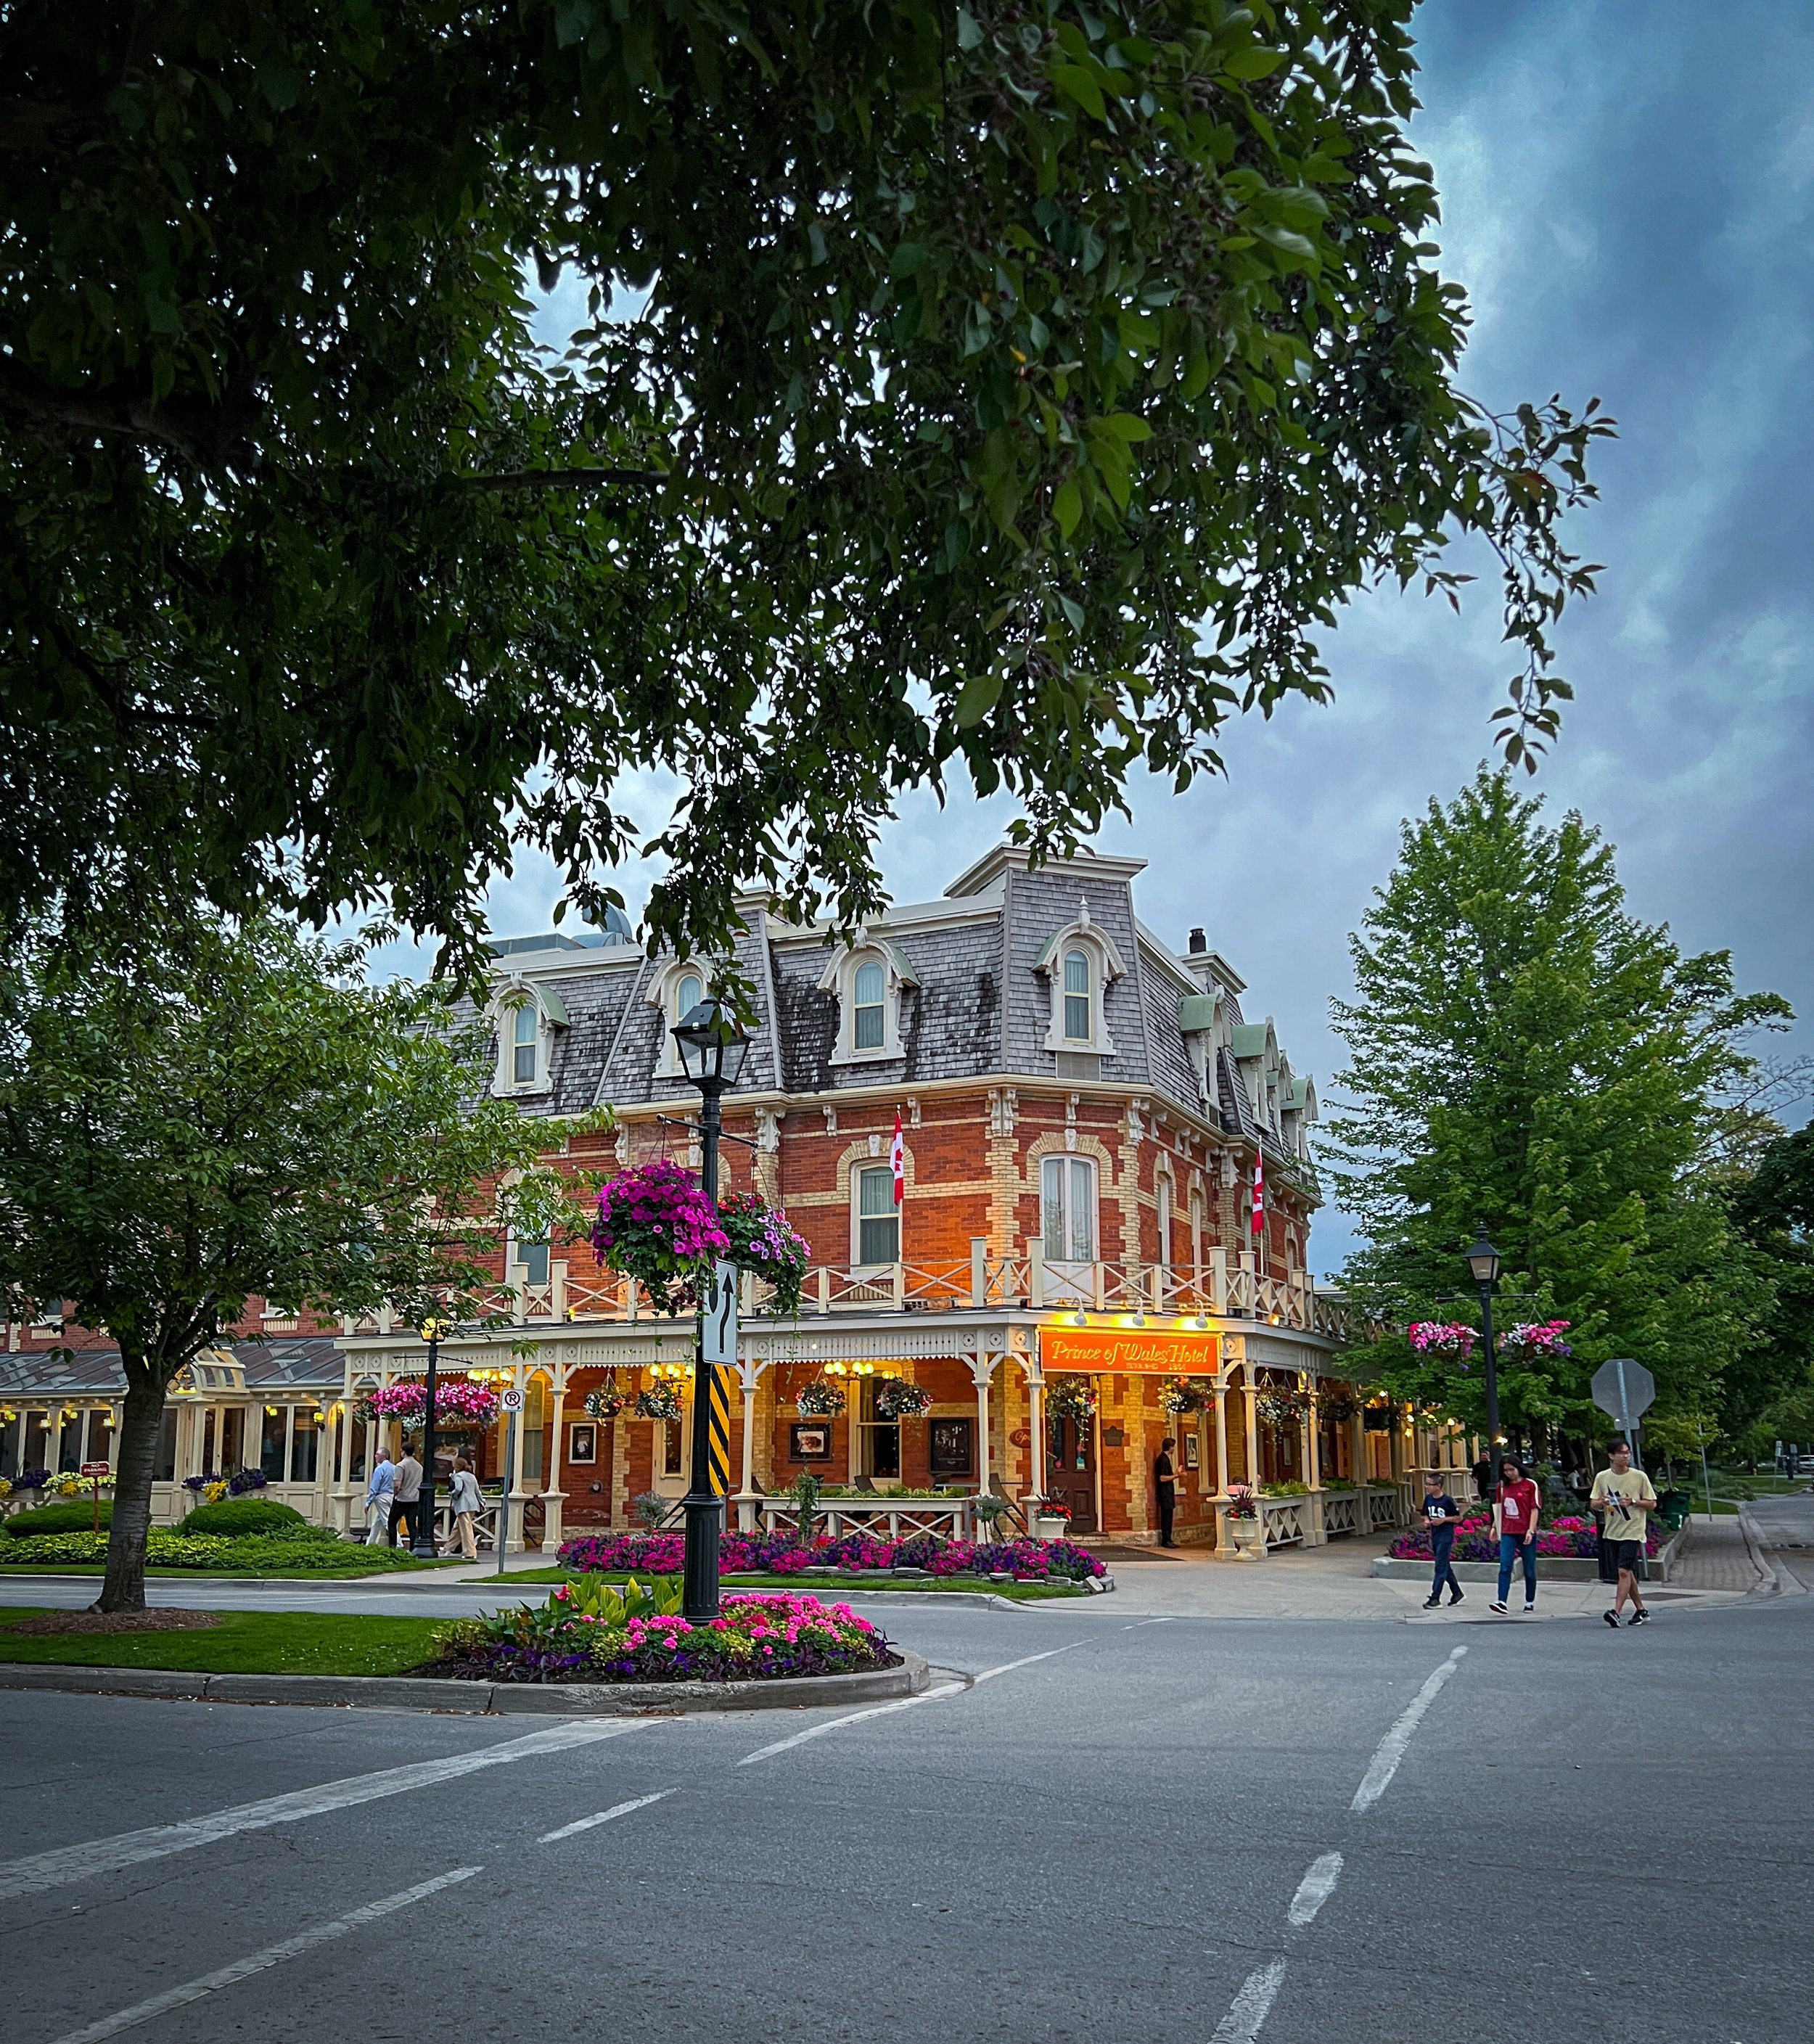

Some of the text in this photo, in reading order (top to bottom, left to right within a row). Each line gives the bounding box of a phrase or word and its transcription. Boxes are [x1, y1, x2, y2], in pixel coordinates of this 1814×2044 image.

[1051, 1340, 1208, 1366] Prince of Wales Hotel
[1015, 1430, 1031, 1444] Op
